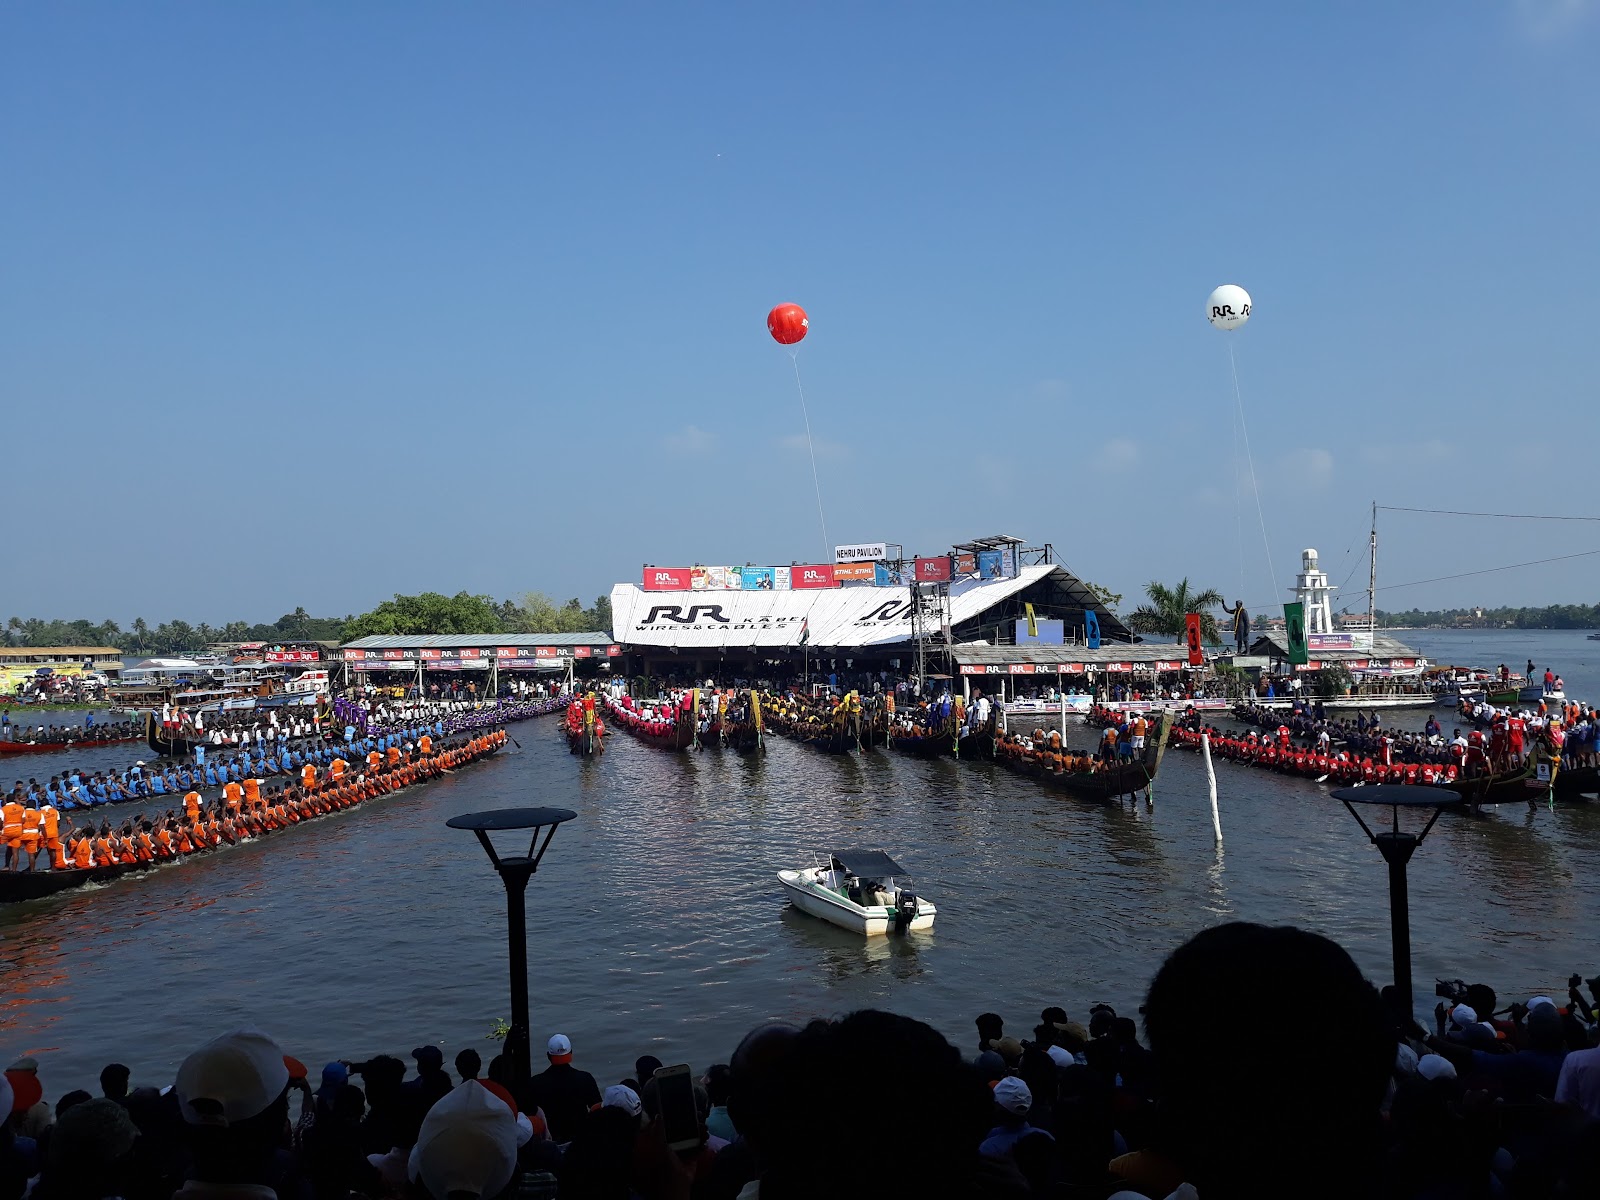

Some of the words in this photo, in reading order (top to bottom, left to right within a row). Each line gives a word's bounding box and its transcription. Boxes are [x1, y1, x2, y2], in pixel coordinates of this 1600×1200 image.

[1212, 304, 1236, 318] RR
[836, 548, 856, 558] NEHRU
[857, 548, 882, 557] PAVILION
[804, 570, 818, 578] RR
[924, 563, 936, 571] RR
[641, 605, 730, 624] RR
[1090, 620, 1096, 638] 2
[1190, 628, 1197, 651] 3
